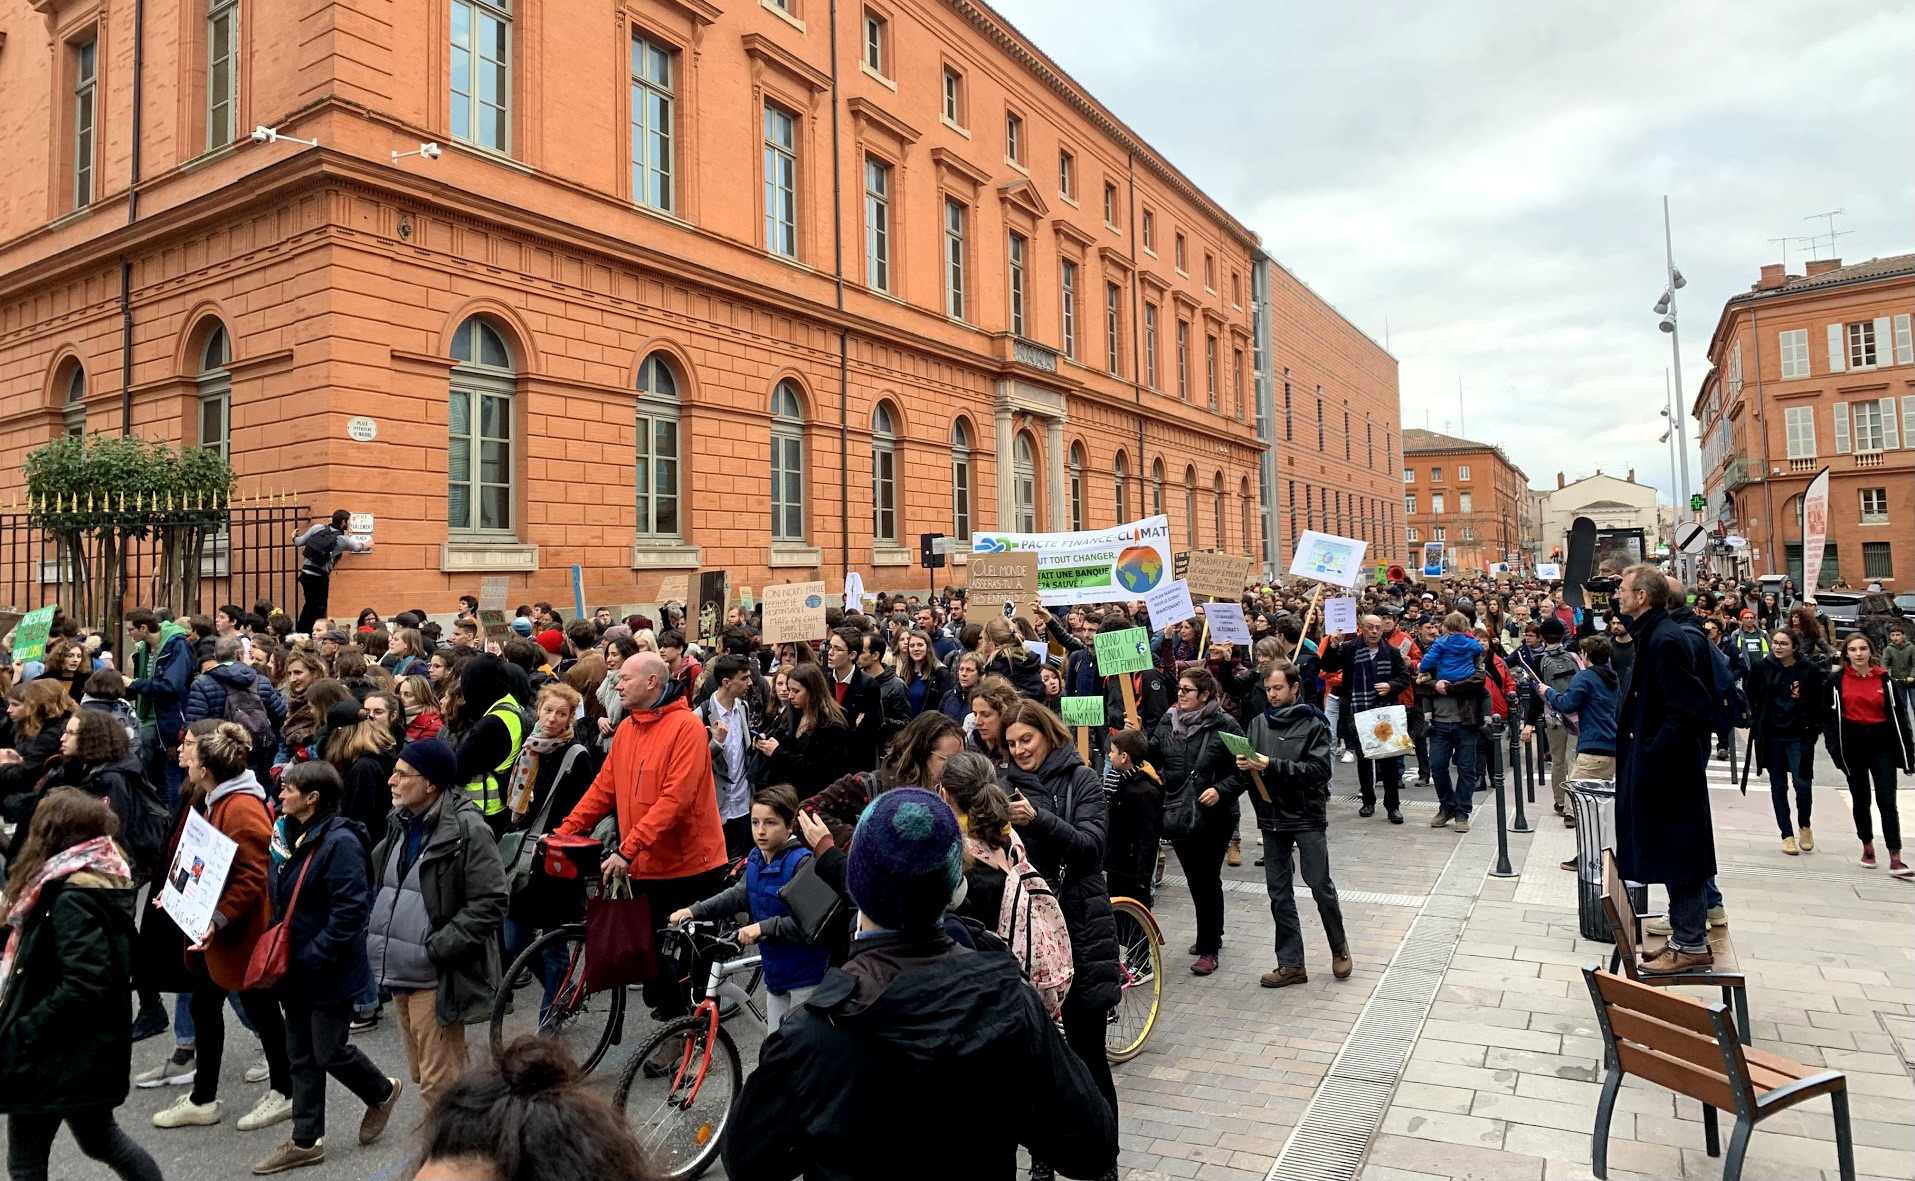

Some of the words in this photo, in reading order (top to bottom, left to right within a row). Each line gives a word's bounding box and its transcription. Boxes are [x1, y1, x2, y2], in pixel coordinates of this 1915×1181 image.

[1021, 538, 1057, 550] PACTE
[1037, 557, 1047, 565] UT
[1049, 555, 1071, 564] TOUT
[1073, 551, 1117, 563] CHANGER.
[1194, 556, 1233, 569] PRIORITÉ
[1234, 562, 1247, 570] AU
[972, 558, 998, 577] QUEL
[999, 565, 1028, 577] MONDE
[1037, 571, 1054, 580] TAIT
[1056, 570, 1074, 579] UNE
[1075, 567, 1111, 578] BANQUE,
[969, 578, 1013, 589] LAISSERAS-TU
[1015, 577, 1024, 589] À
[1052, 577, 1079, 589] SAUVÉ
[1188, 575, 1210, 583] LOCAL
[765, 589, 781, 599] ON
[782, 586, 804, 597] NOUS
[805, 585, 825, 594] PARLE
[972, 593, 985, 604] TES
[987, 592, 1019, 604] ENFANTS
[1022, 591, 1028, 601] ?
[1154, 600, 1164, 608] POUR
[1168, 593, 1181, 603] CLIMAT
[1155, 601, 1181, 615] MAINTENANT
[769, 616, 788, 625] MAIS
[790, 616, 801, 624] ON
[780, 624, 797, 633] DANS
[799, 623, 816, 632] L'EAU
[780, 631, 809, 641] POTABLE
[1095, 633, 1120, 650] QUAND
[1124, 627, 1146, 644] C'EST
[1097, 647, 1125, 662] FONDU
[1099, 660, 1119, 675] C'EST
[1085, 697, 1101, 711] LES
[1063, 712, 1102, 725] ANIMAUX
